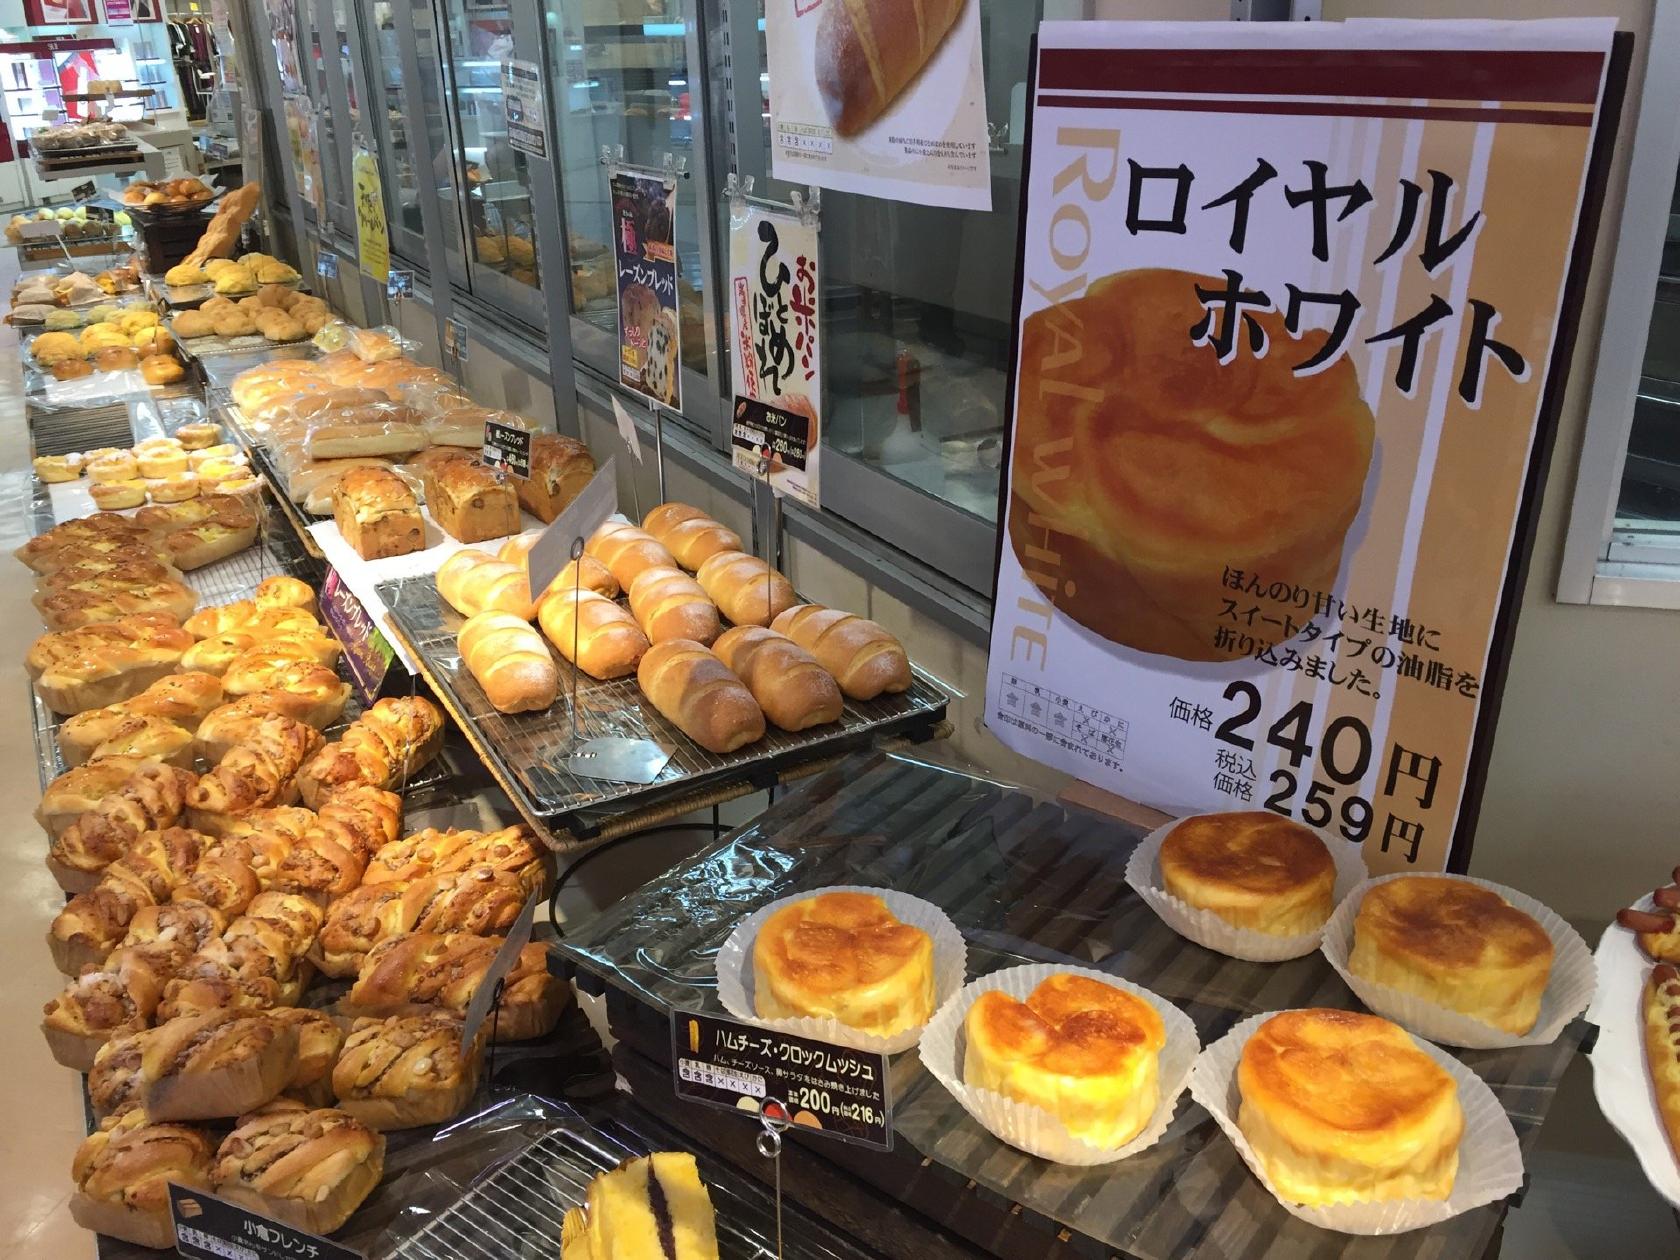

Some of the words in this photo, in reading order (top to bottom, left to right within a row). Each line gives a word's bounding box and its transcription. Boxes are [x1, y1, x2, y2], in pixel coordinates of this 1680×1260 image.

[1126, 155, 1481, 272] ロイヤル
[618, 259, 674, 296] レーズンブレッド
[1190, 269, 1527, 404] ホワイト
[1221, 565, 1441, 652] ほんのり甘い生地に
[1213, 625, 1382, 700] 折り込みました。
[1217, 597, 1481, 699] スイートタイプの油脂を
[1168, 696, 1214, 731] 価格
[1213, 771, 1254, 803] 価格
[1215, 749, 1257, 781] 税込
[715, 1029, 874, 1081] ハムチーズ・クロックムッシュ
